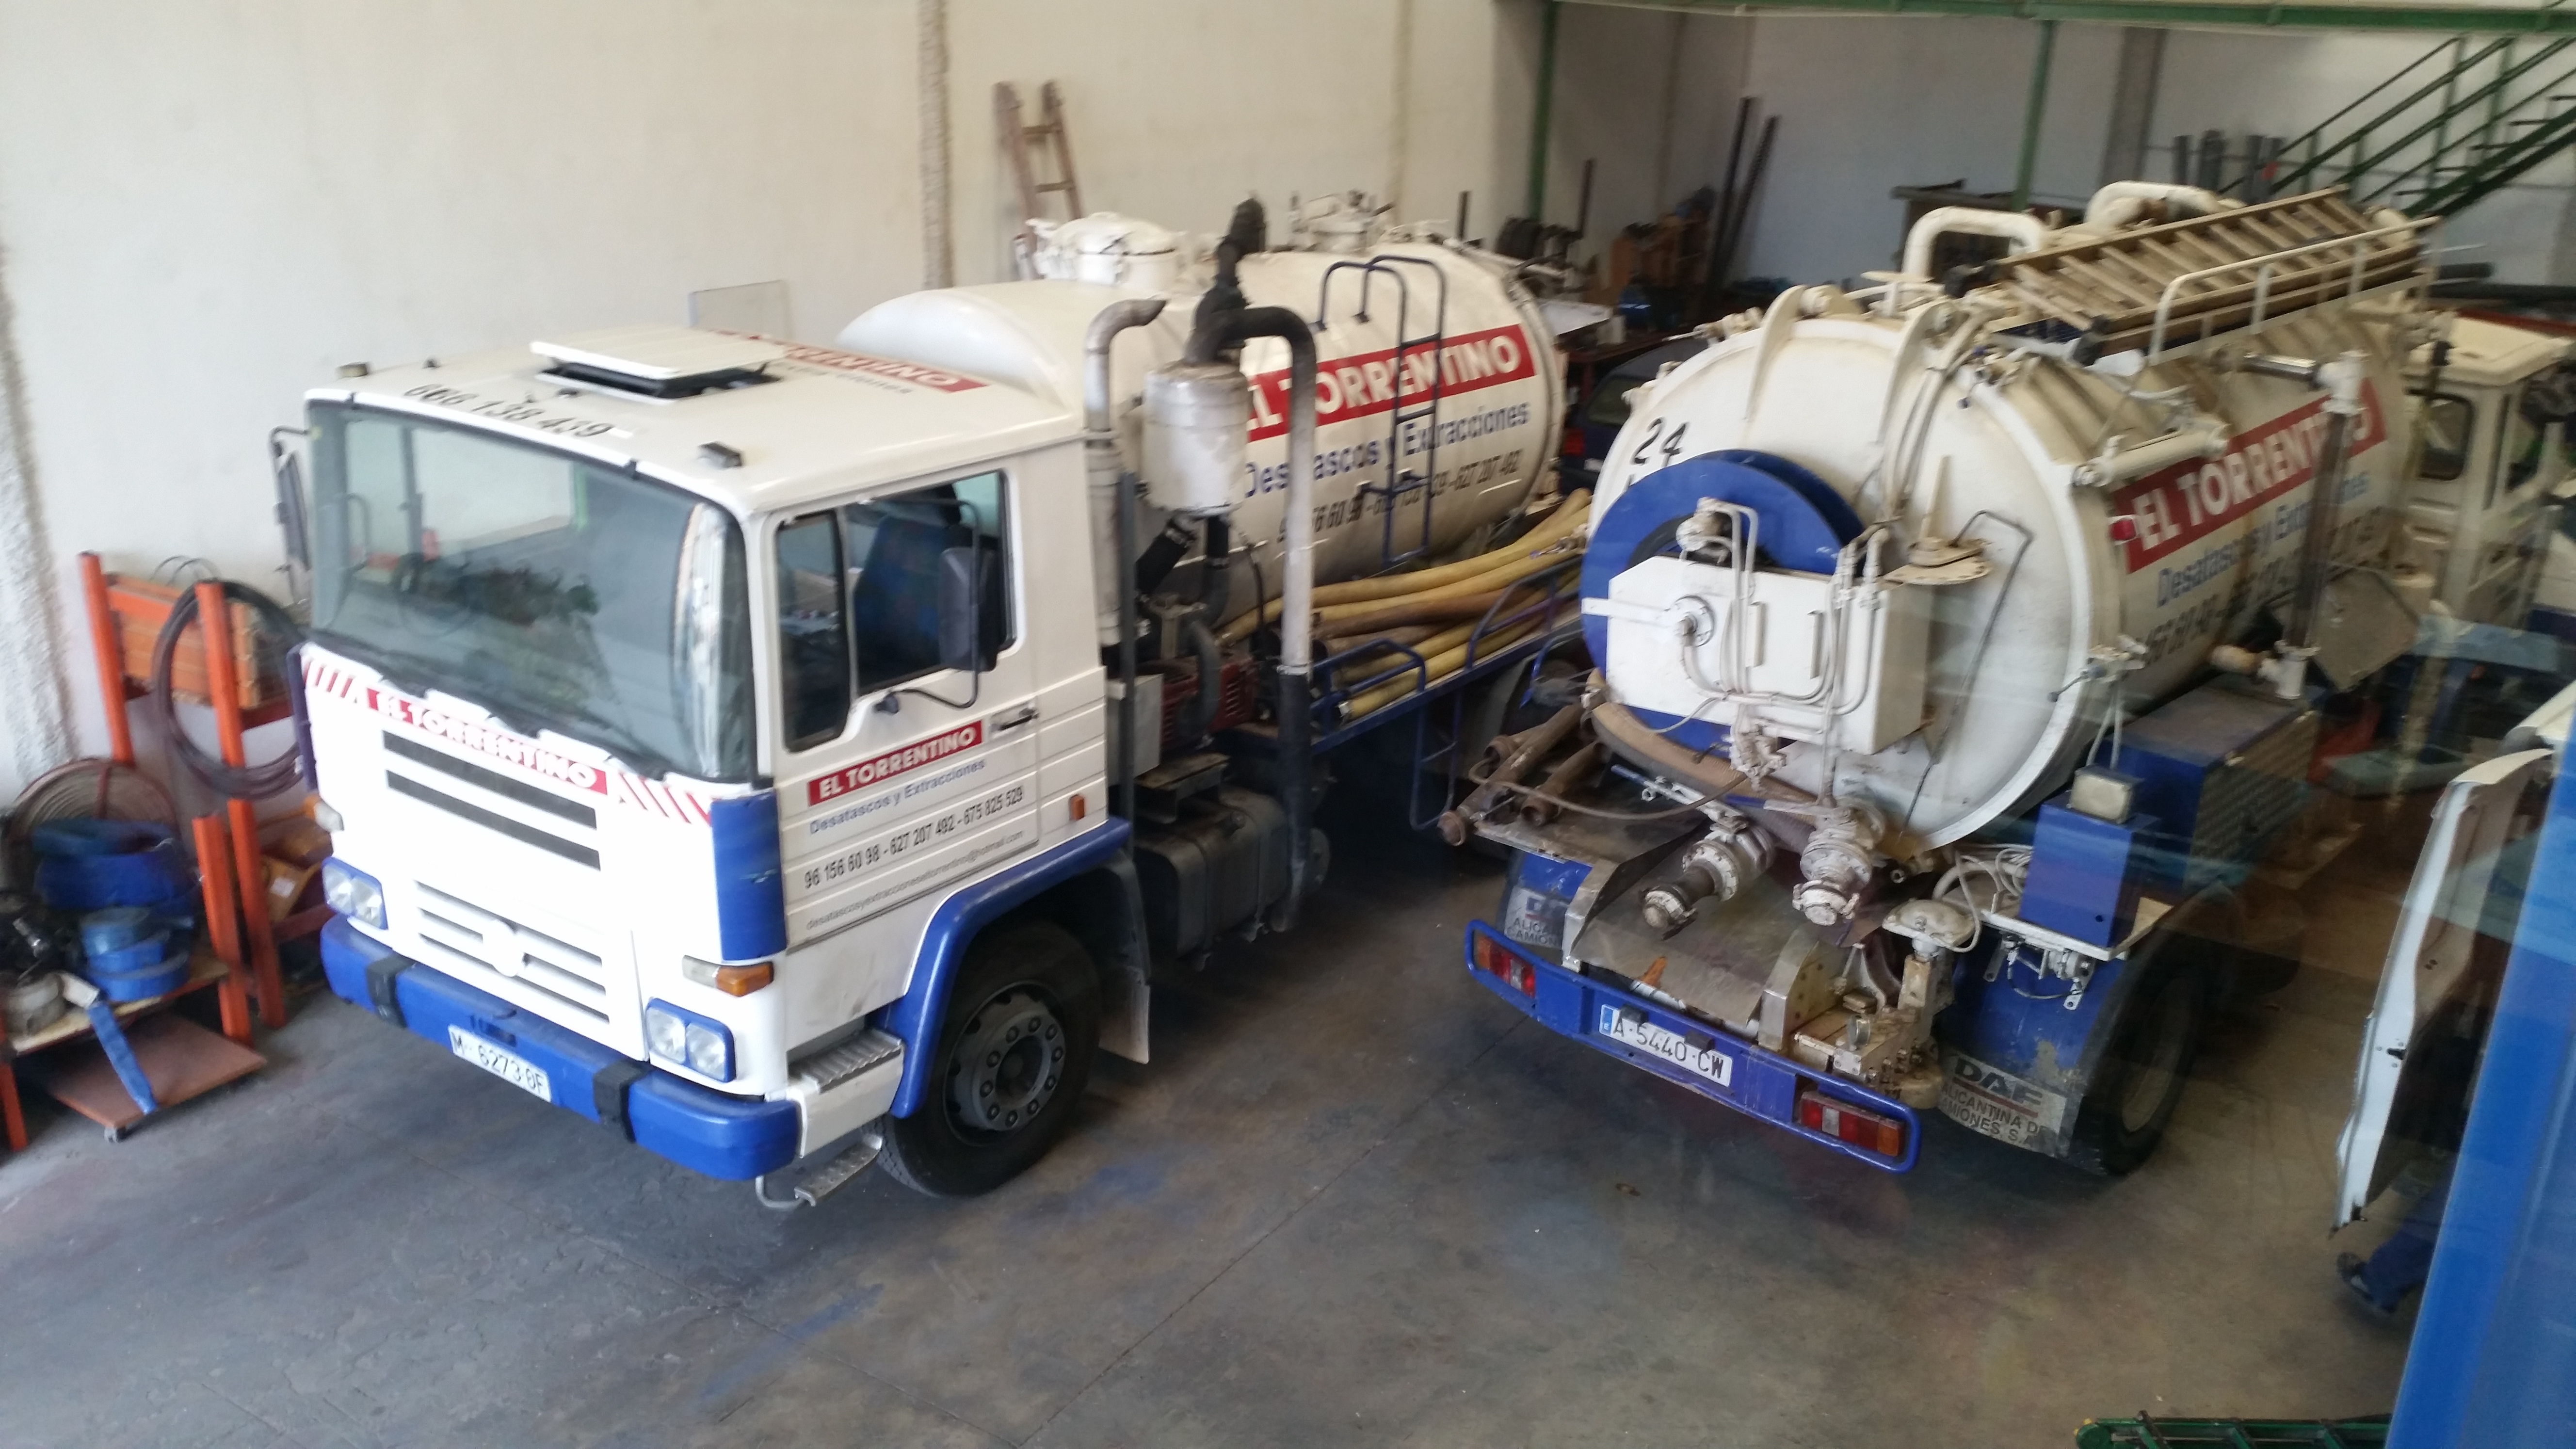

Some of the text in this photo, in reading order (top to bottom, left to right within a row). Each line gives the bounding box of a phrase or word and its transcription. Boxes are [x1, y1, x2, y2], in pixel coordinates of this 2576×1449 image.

[404, 384, 479, 405] 666
[471, 400, 546, 421] 138
[1630, 417, 1690, 467] 24
[2131, 487, 2181, 550] EL
[376, 692, 597, 789] EL TORRENTINO
[819, 725, 978, 799] EL TORRENTINO
[810, 794, 891, 835] Desatascos
[903, 758, 987, 799] Extracciones
[804, 869, 821, 889] 96
[823, 854, 844, 881] 156
[847, 849, 862, 871] 60
[864, 841, 880, 865] 98
[889, 832, 910, 856] 627
[912, 823, 933, 845] 207
[935, 814, 956, 837] 492
[1954, 1057, 2043, 1106] DAF
